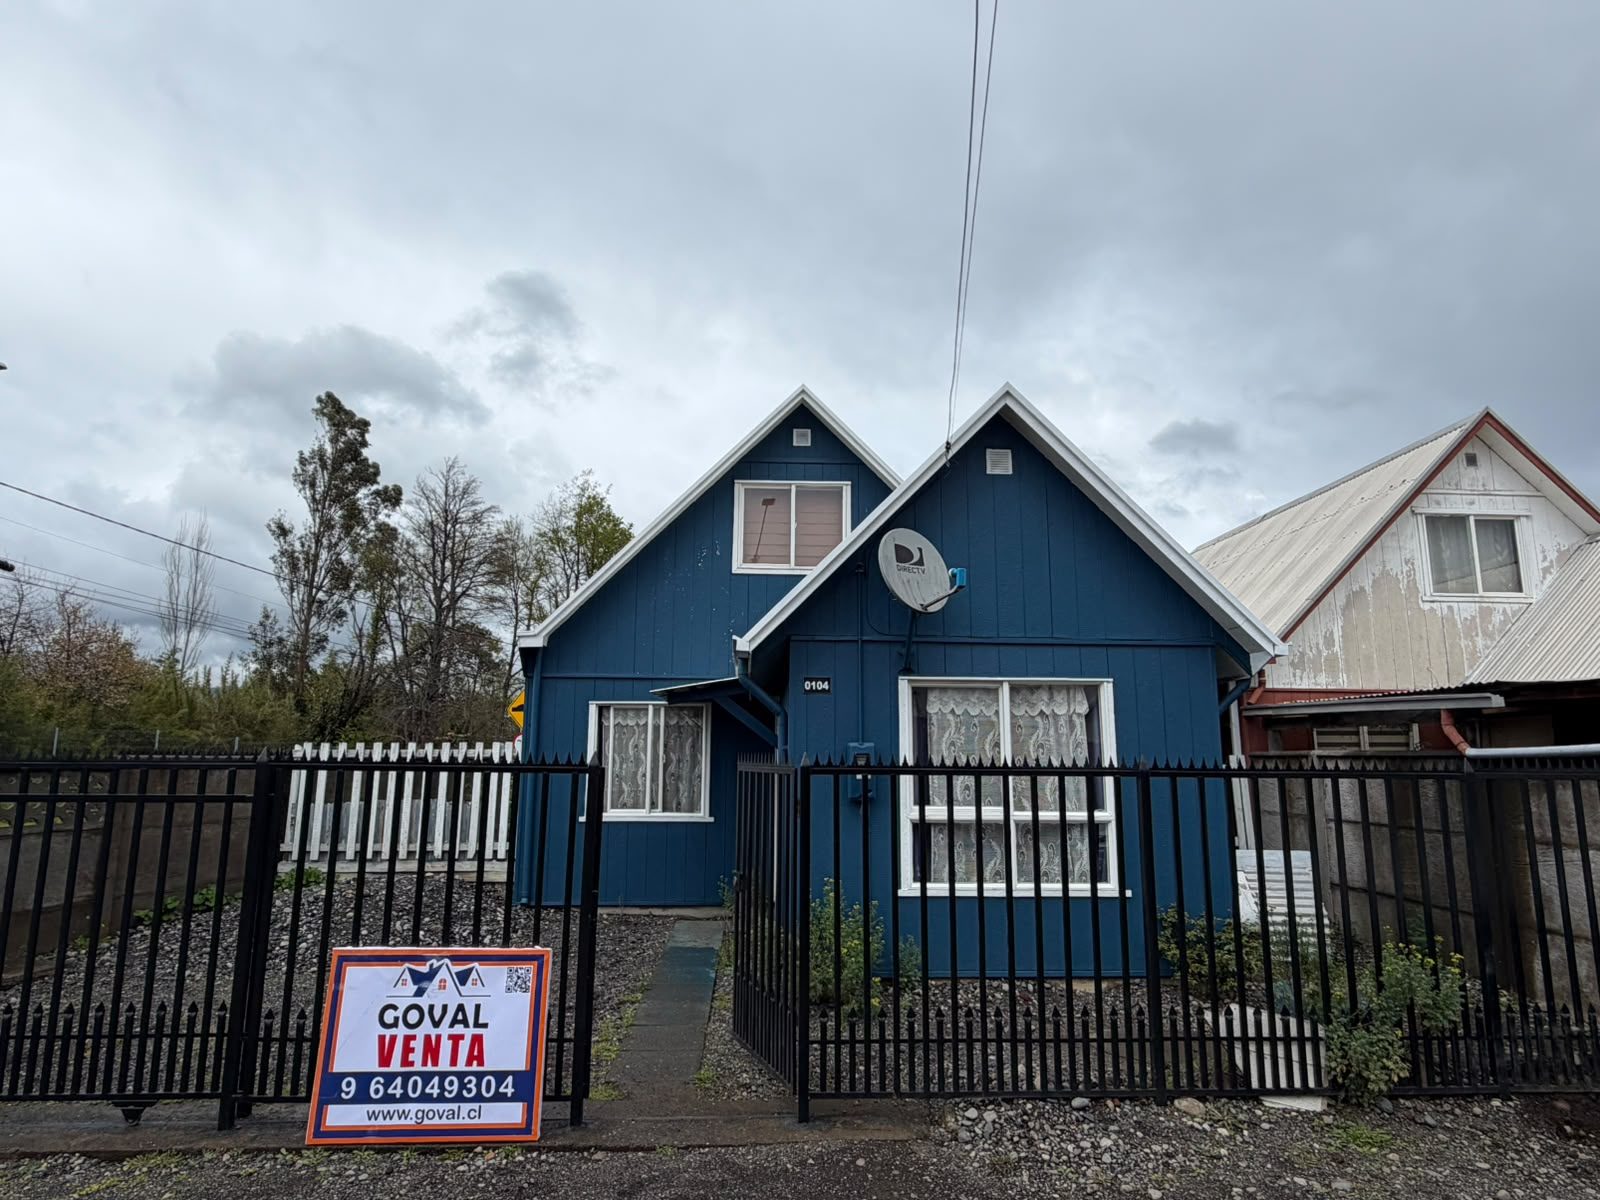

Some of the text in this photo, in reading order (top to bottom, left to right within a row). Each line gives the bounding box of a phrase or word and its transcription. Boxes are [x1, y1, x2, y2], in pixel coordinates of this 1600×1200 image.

[896, 564, 926, 575] DIRECTV
[804, 680, 829, 690] 0104
[378, 1003, 489, 1030] GOVAL
[377, 1033, 485, 1068] VENTA
[340, 1075, 515, 1100] 9 64049304
[366, 1104, 482, 1125] www.goval.cl
